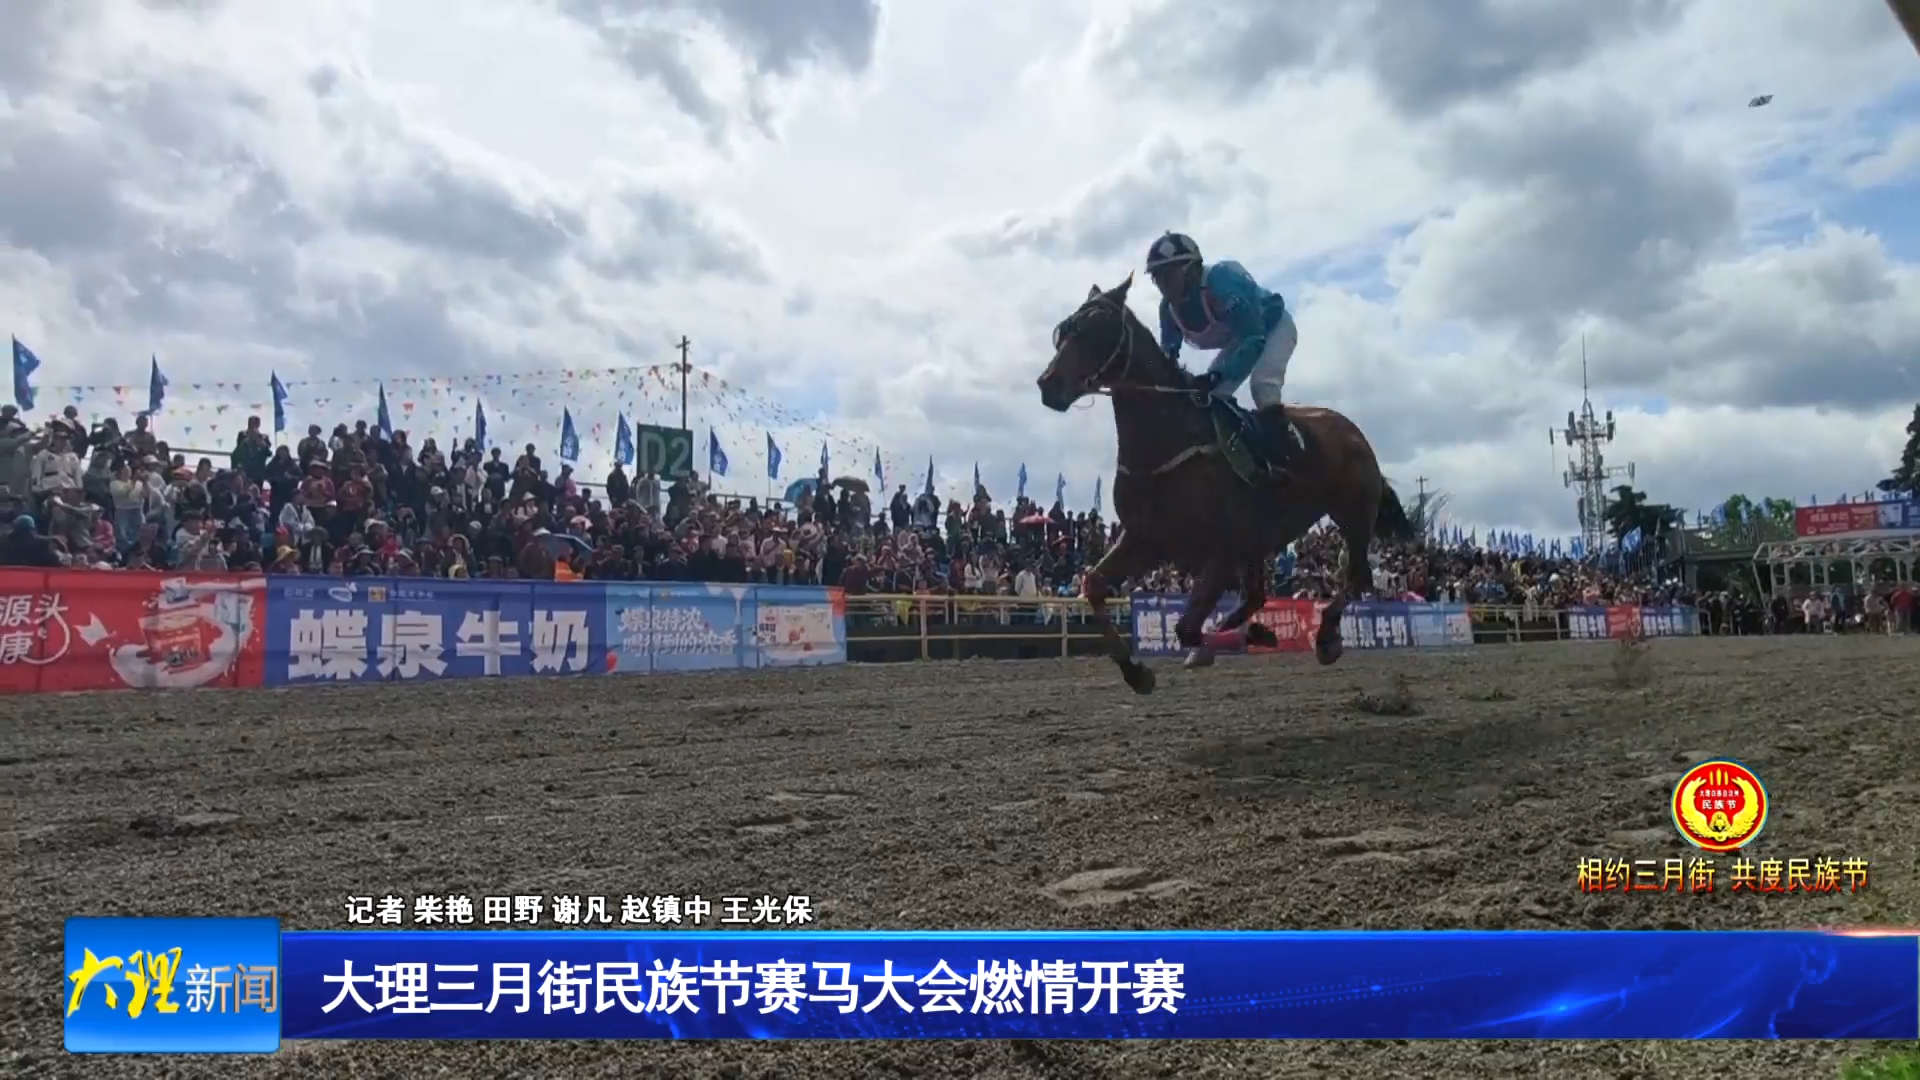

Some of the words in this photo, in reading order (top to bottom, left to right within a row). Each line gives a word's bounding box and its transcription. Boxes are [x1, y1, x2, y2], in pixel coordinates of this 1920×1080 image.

[641, 431, 691, 477] D2
[288, 609, 589, 680] 蝶泉牛奶
